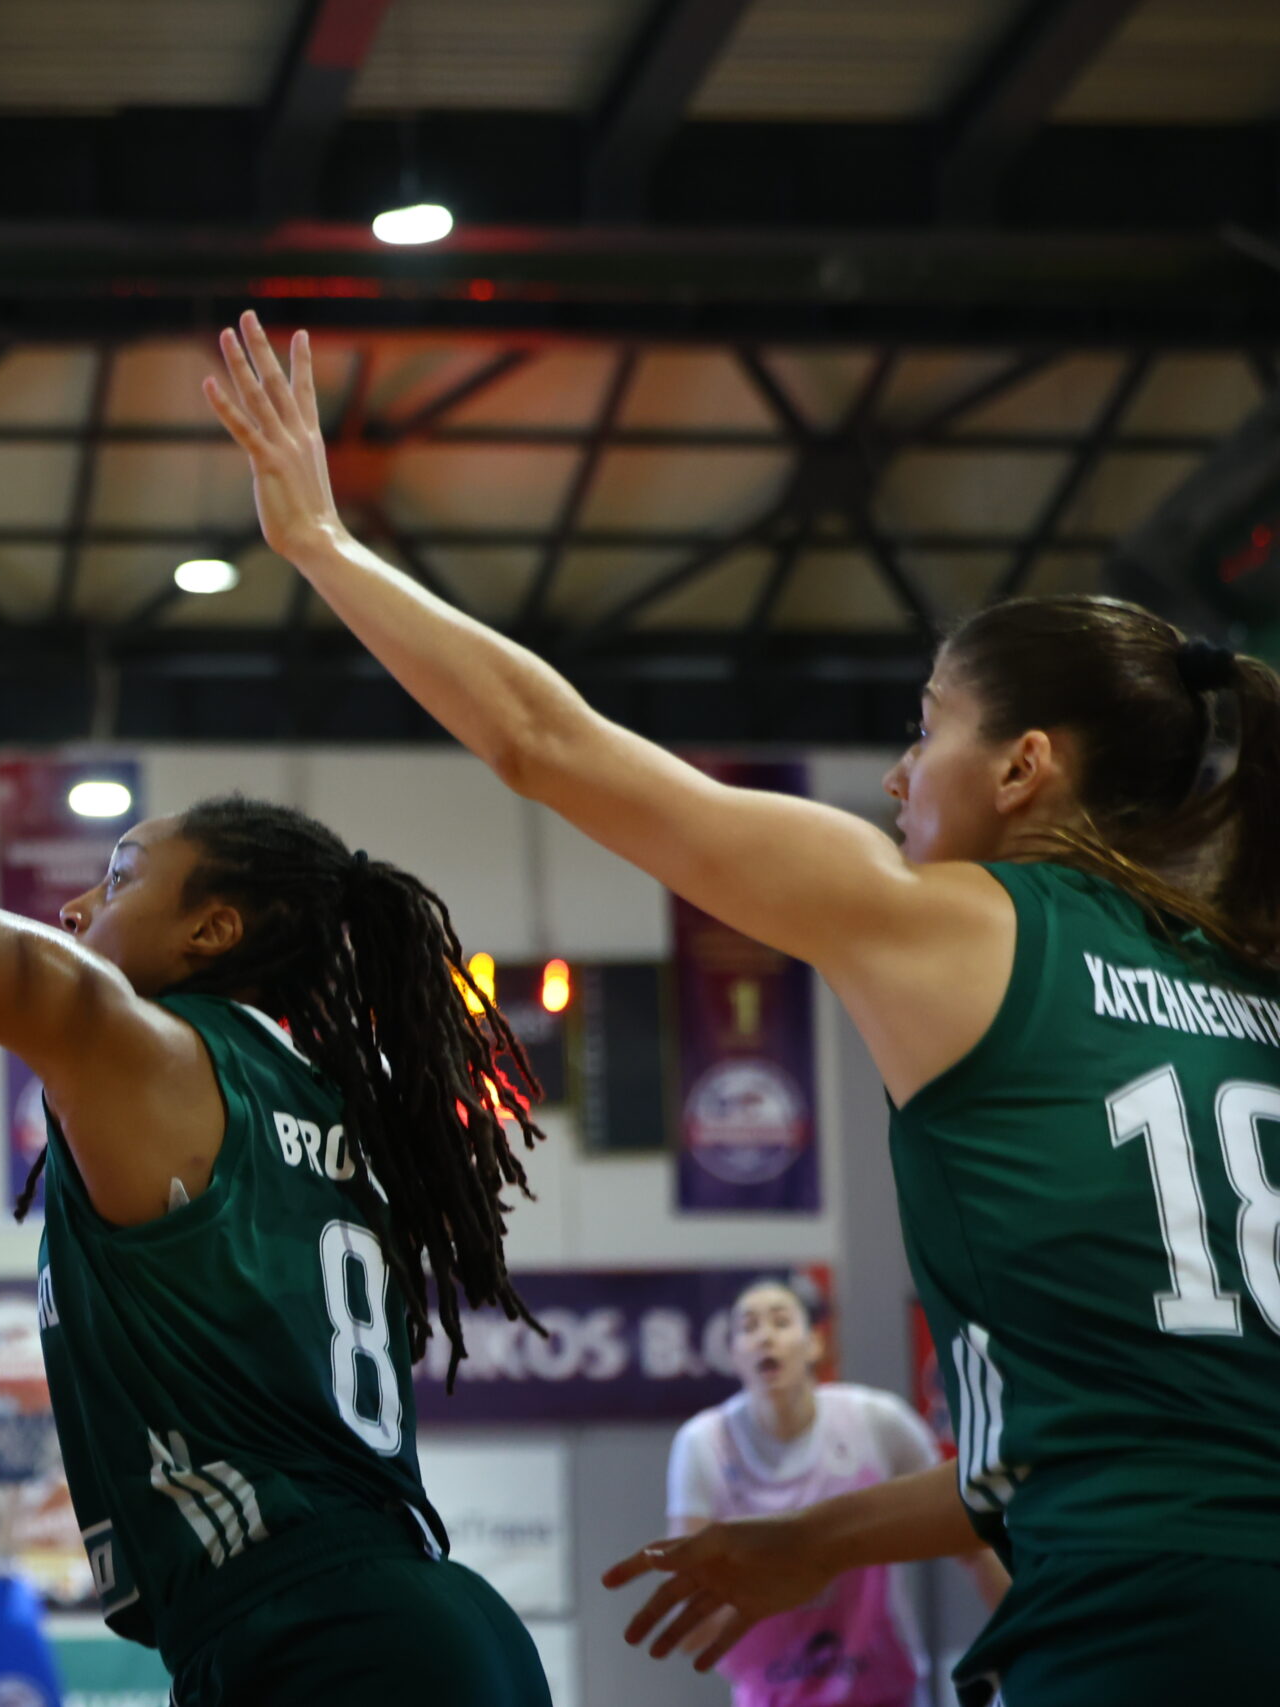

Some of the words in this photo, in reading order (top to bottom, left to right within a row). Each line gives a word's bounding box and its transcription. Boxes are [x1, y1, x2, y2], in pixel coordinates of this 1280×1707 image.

[273, 1111, 389, 1204] BRO
[1104, 1063, 1280, 1338] 18
[319, 1219, 402, 1457] 8
